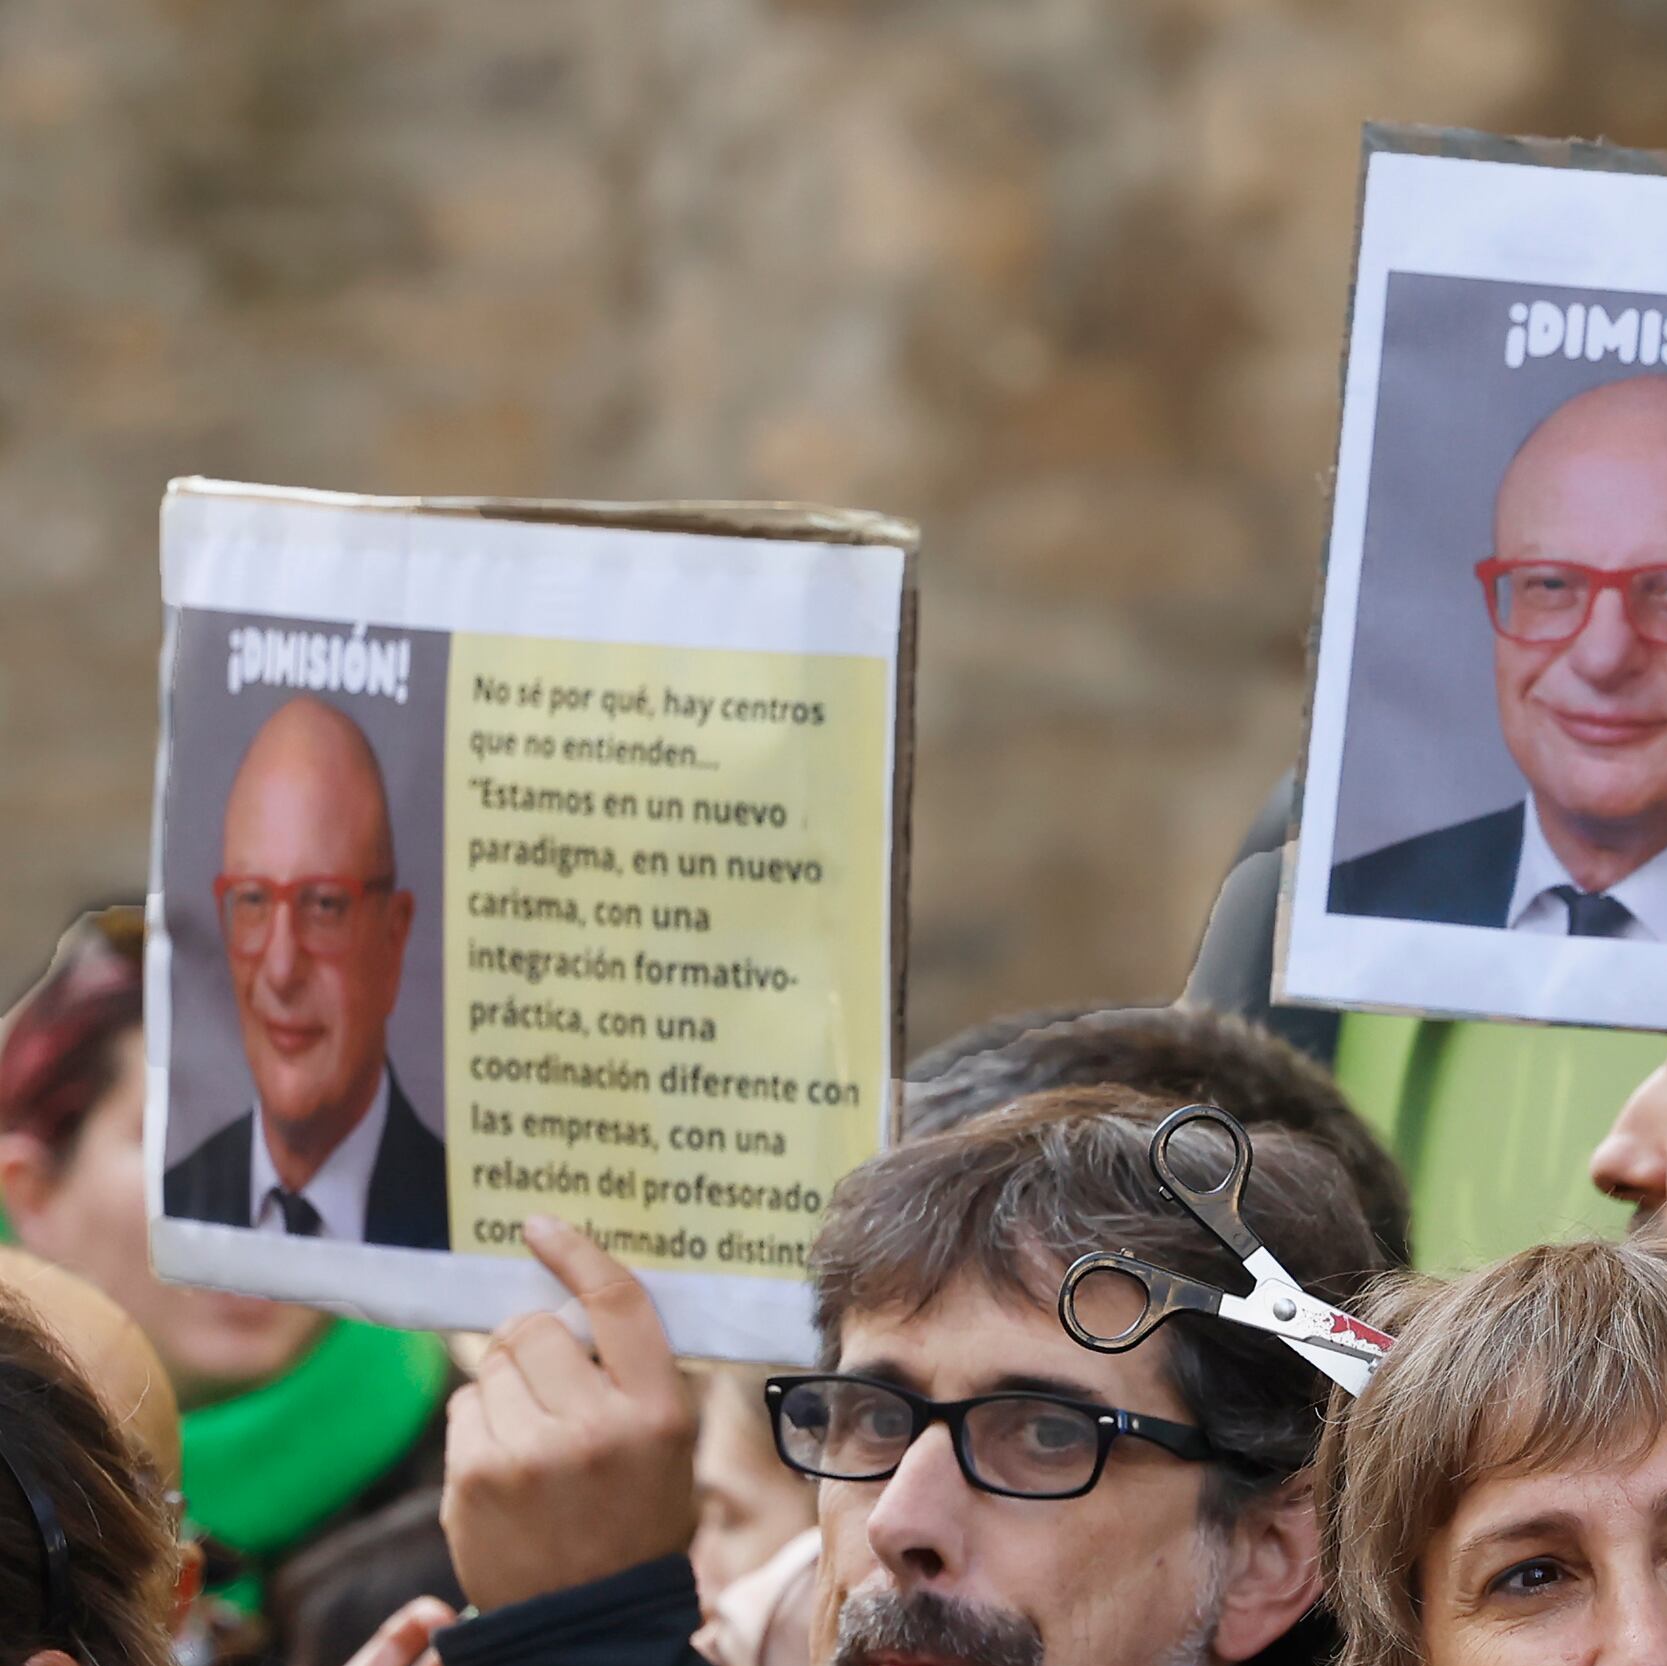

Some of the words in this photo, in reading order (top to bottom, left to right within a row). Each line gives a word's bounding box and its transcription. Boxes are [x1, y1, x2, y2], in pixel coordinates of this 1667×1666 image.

[472, 675, 510, 706] No
[517, 677, 544, 709] sé
[548, 687, 593, 718] por
[601, 684, 653, 722] qué,
[663, 686, 710, 728] hay
[721, 695, 825, 727] centros
[469, 731, 516, 760] que
[524, 731, 555, 757] no
[563, 735, 720, 771] entienden...
[604, 793, 637, 818] en
[647, 796, 682, 822] un
[694, 798, 788, 829] nuevo
[468, 836, 623, 879] paradigma,
[632, 850, 667, 877] en
[678, 851, 717, 878] un
[728, 854, 822, 884] nuevo
[468, 890, 587, 928] carisma,
[594, 901, 642, 928] con
[652, 906, 711, 932] una
[468, 938, 626, 984] integración
[634, 950, 799, 992] formativo-
[469, 995, 590, 1038] práctica,
[598, 1011, 646, 1038] con
[656, 1015, 717, 1042] una
[470, 1053, 649, 1092] coordinación
[659, 1064, 797, 1099] diferente
[807, 1079, 860, 1107] con
[472, 1104, 513, 1137] las
[522, 1114, 658, 1153] empresas,
[669, 1125, 726, 1152] con
[736, 1131, 785, 1156] una
[473, 1159, 589, 1194] relación
[598, 1171, 637, 1198] del
[644, 1176, 821, 1213] profesorado
[574, 1222, 706, 1260] lumnado
